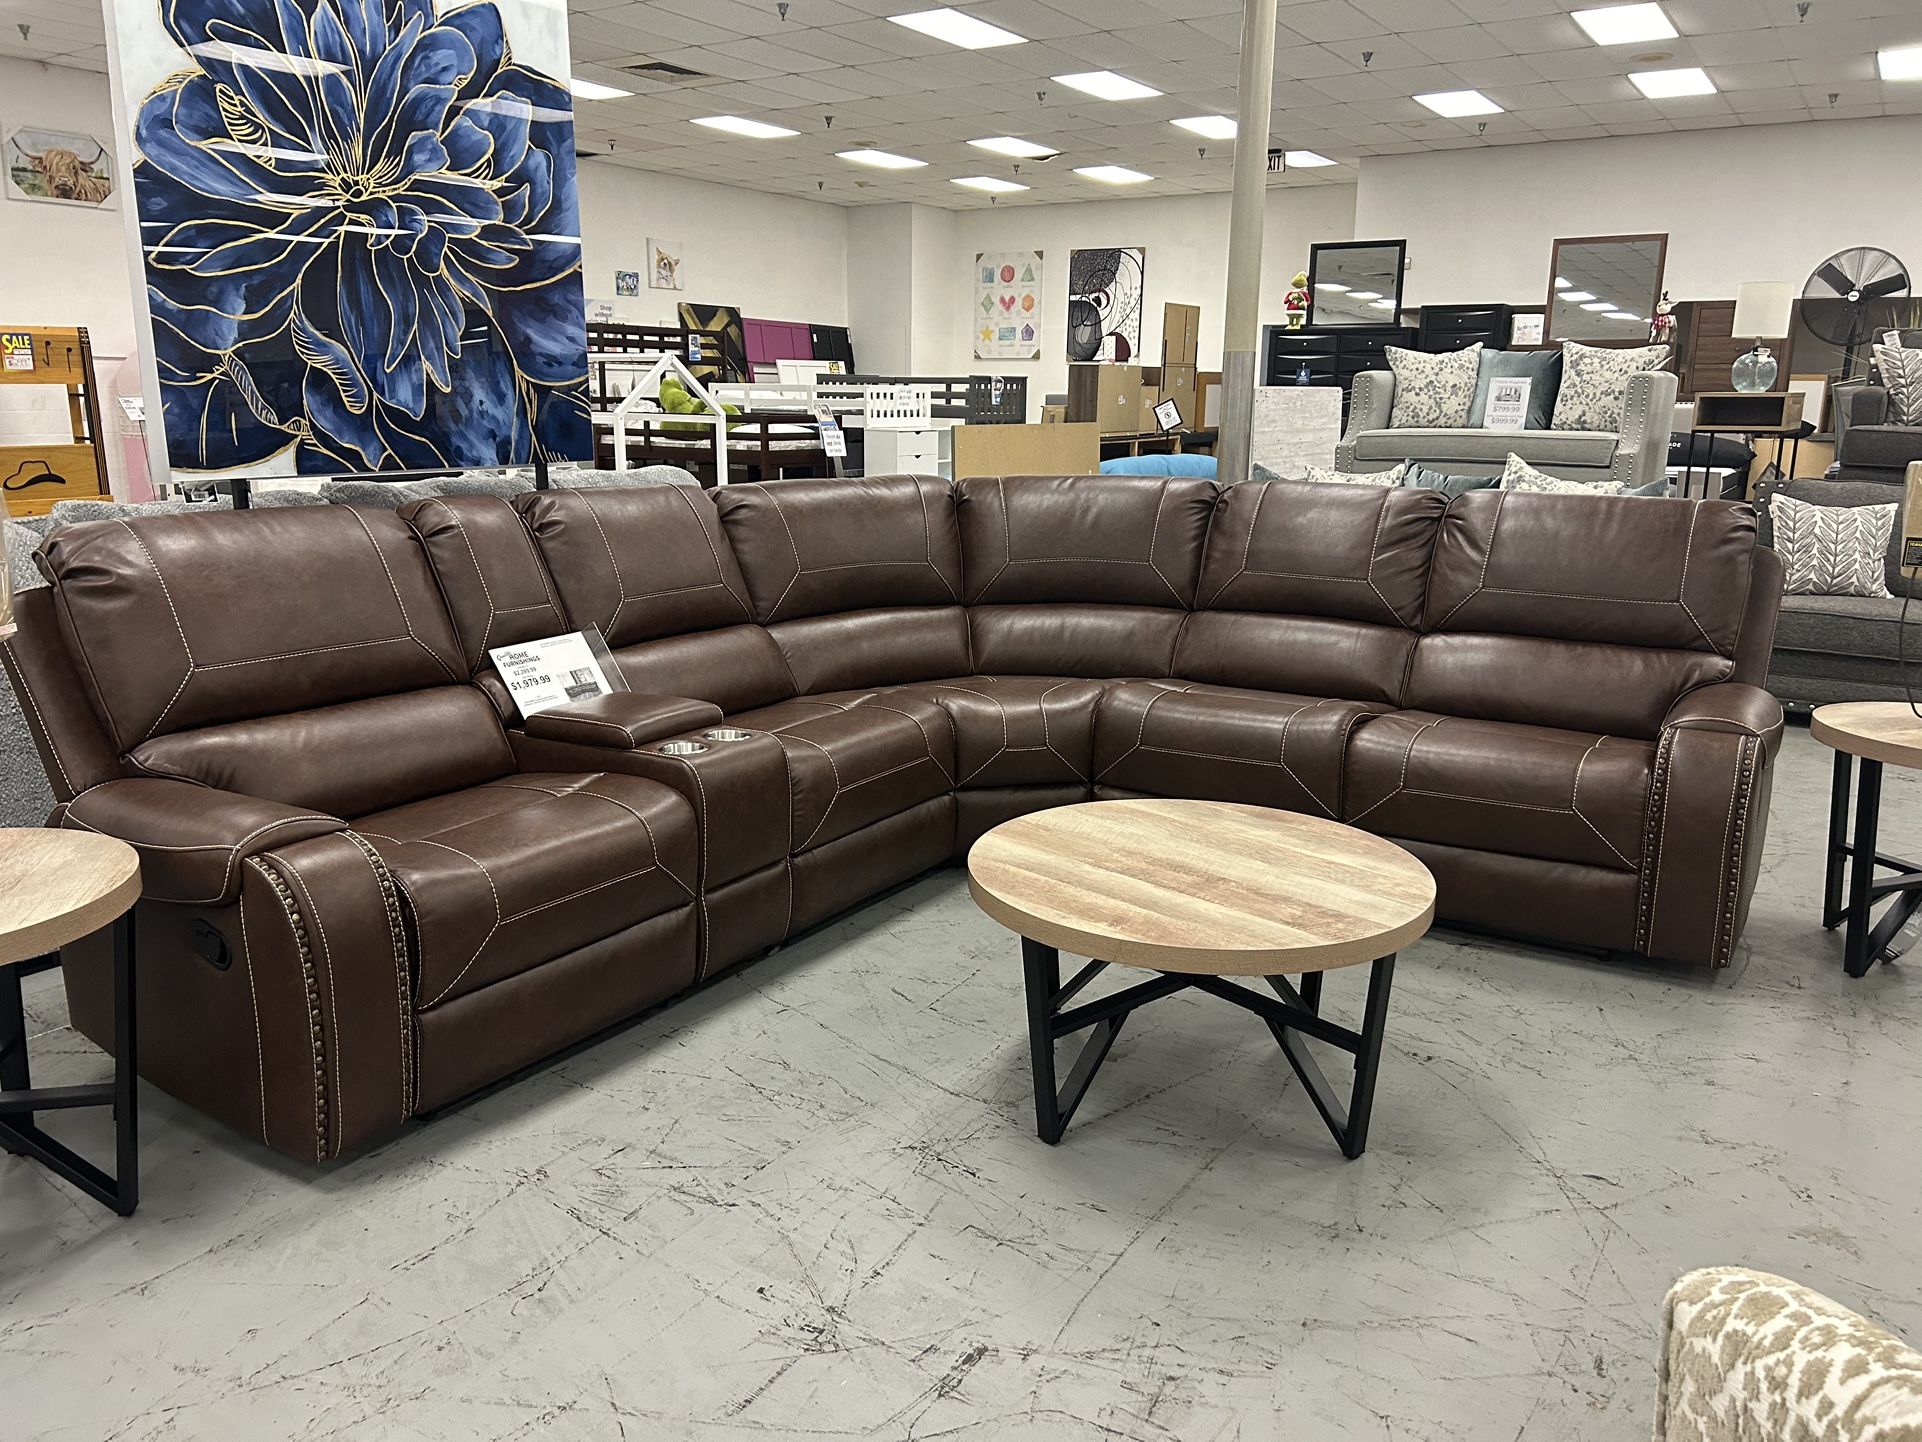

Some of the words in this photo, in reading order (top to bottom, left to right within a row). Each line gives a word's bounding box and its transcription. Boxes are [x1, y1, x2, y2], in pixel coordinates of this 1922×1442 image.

[1266, 155, 1282, 171] XIT
[1, 334, 31, 354] SALE
[503, 655, 540, 667] FURNISHINGS
[509, 651, 529, 661] HOME
[510, 674, 551, 690] $1,979.99
